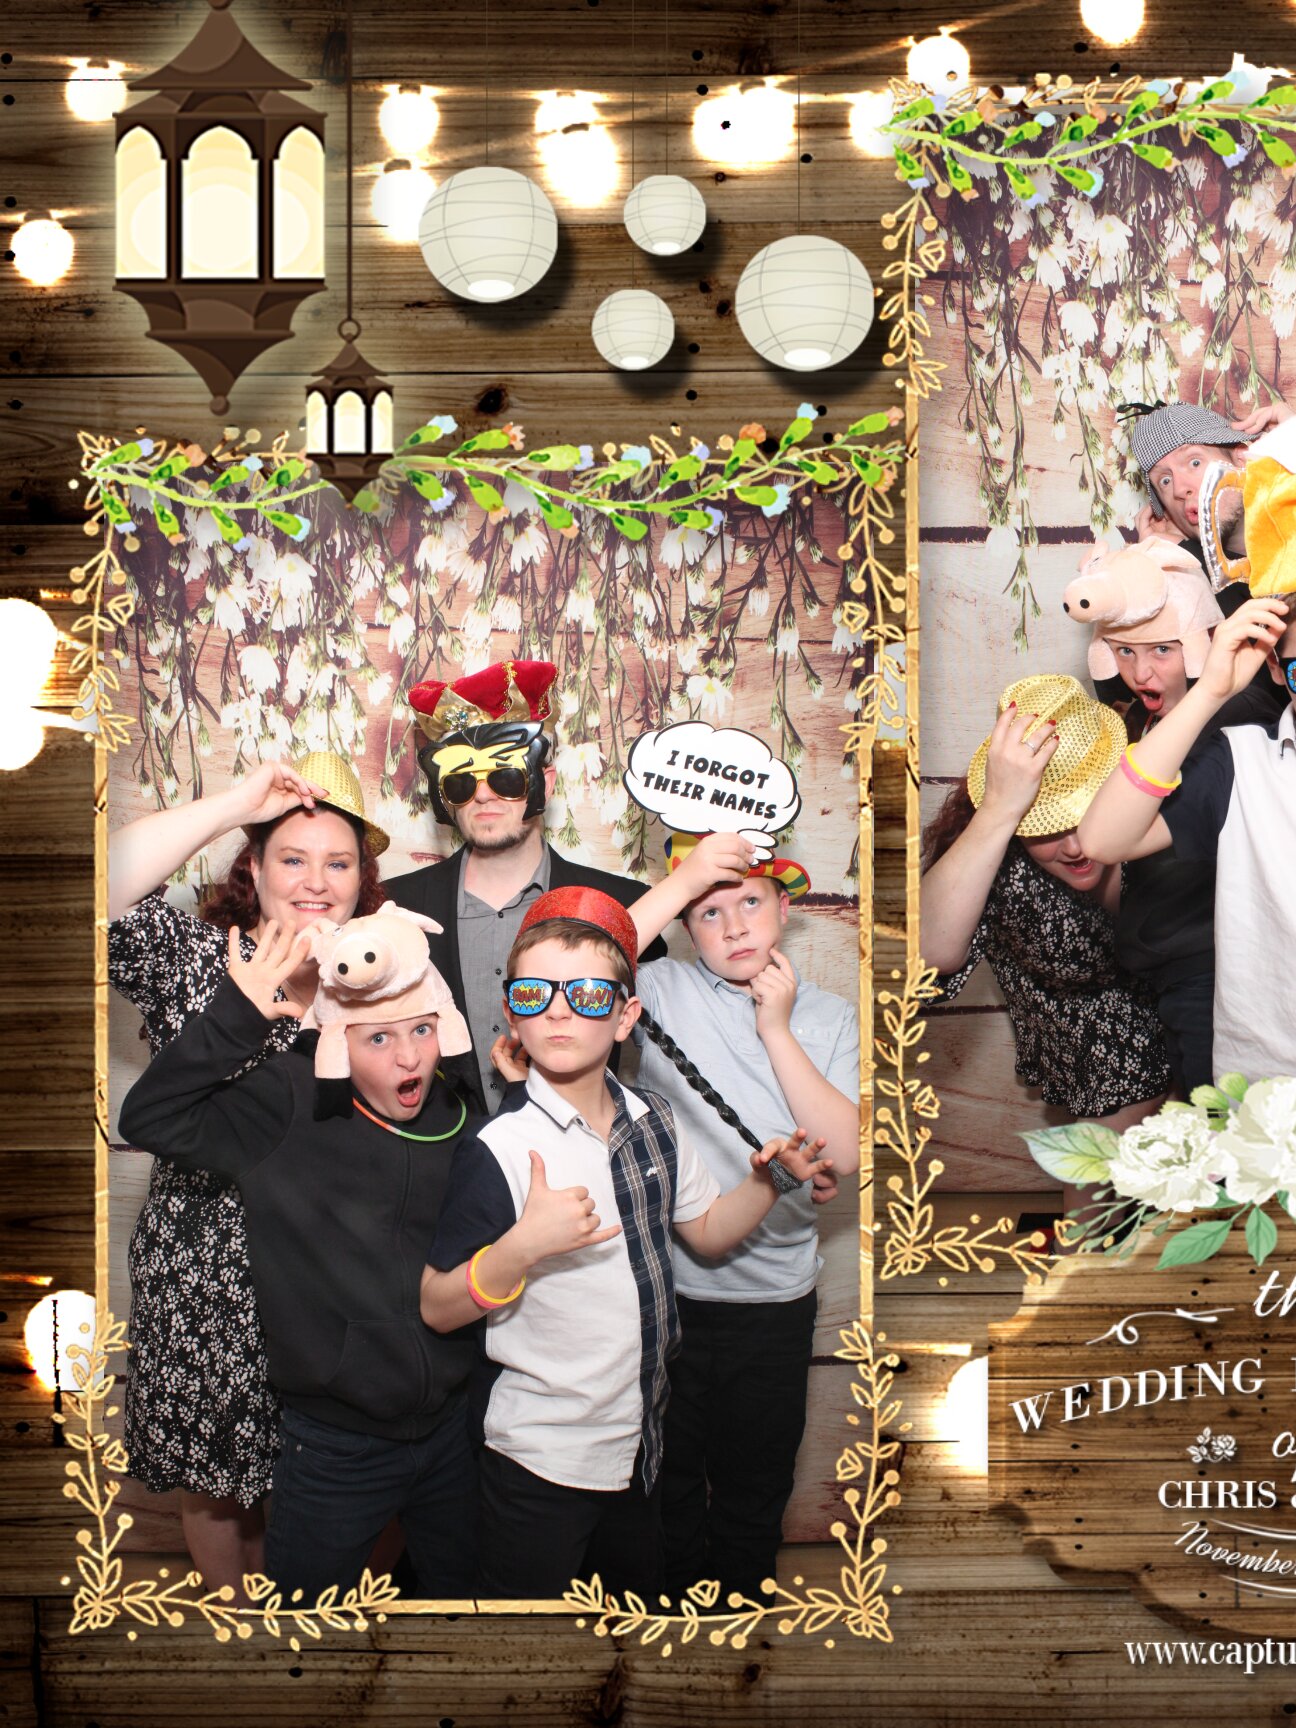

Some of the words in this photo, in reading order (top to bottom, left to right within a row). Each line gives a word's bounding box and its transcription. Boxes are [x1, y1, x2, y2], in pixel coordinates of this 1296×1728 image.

[666, 749, 680, 766] I
[683, 754, 770, 789] FORGOT
[642, 771, 705, 801] THEIR
[709, 788, 777, 819] NAMES
[512, 987, 545, 1003] BAM!
